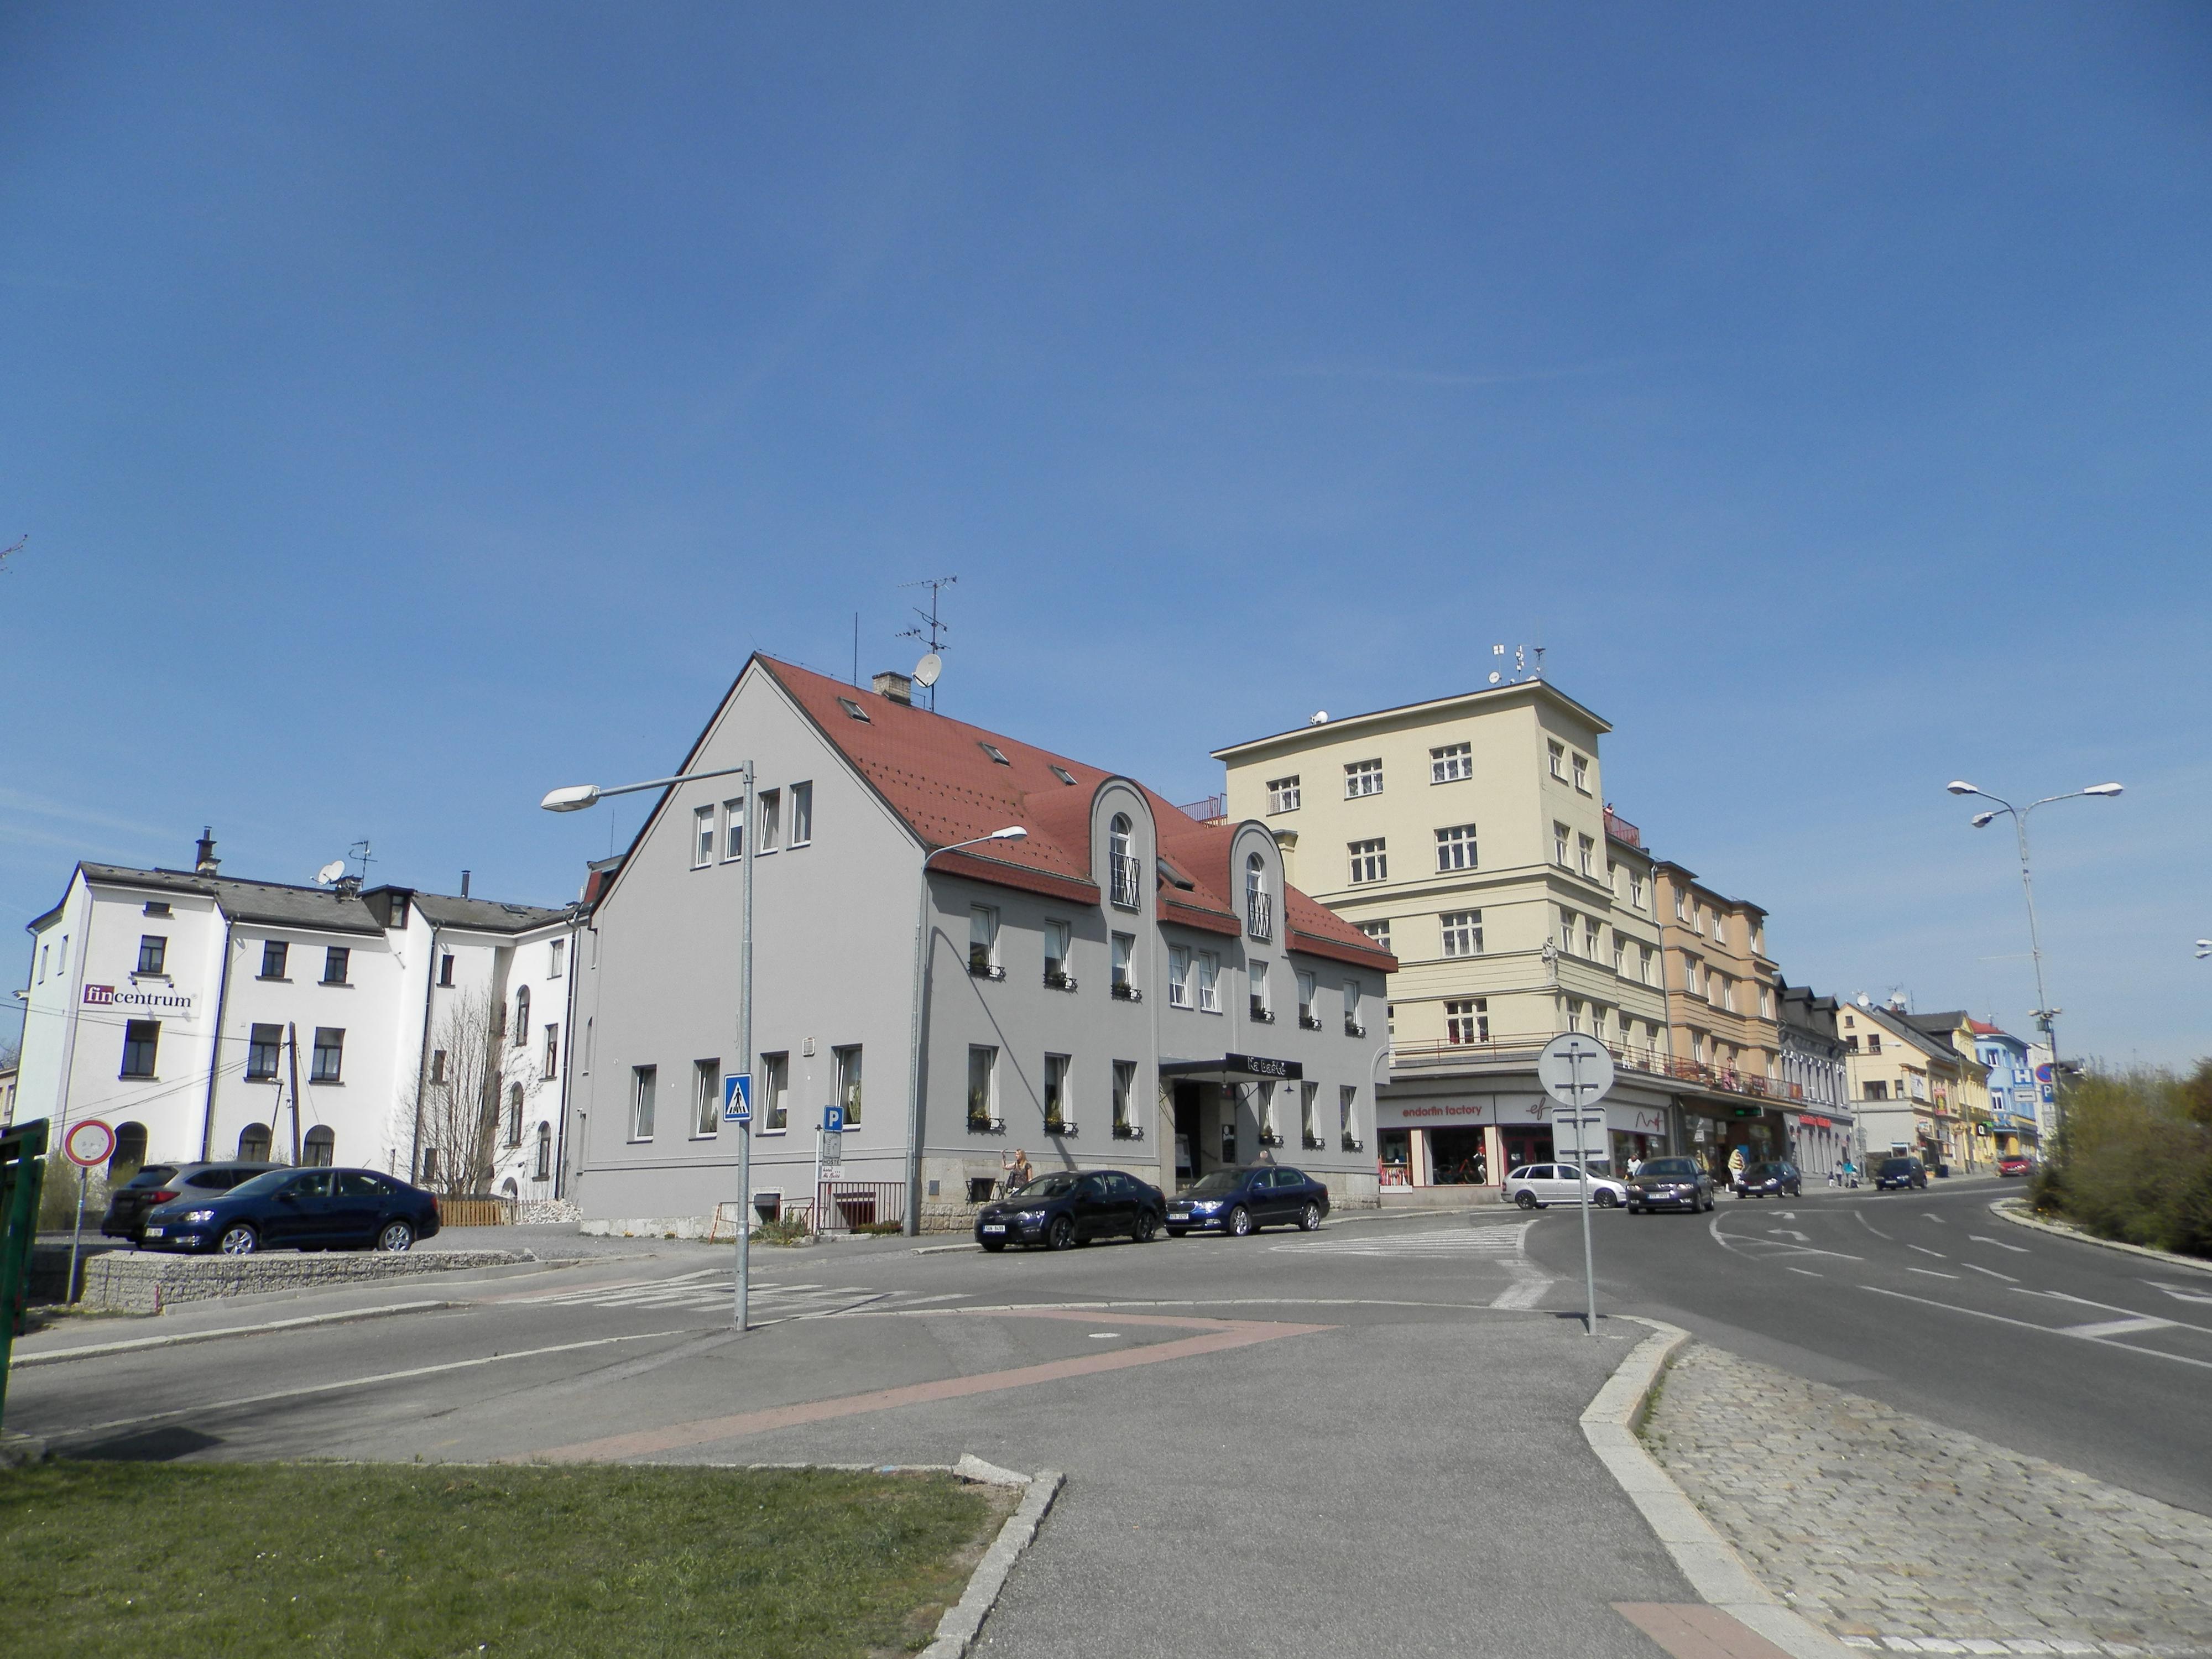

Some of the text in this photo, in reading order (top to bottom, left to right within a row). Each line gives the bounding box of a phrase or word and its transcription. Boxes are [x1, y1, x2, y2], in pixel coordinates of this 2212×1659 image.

[87, 986, 191, 1008] fincentrum
[829, 1110, 839, 1127] P
[1402, 1105, 1482, 1117] endorfin factory
